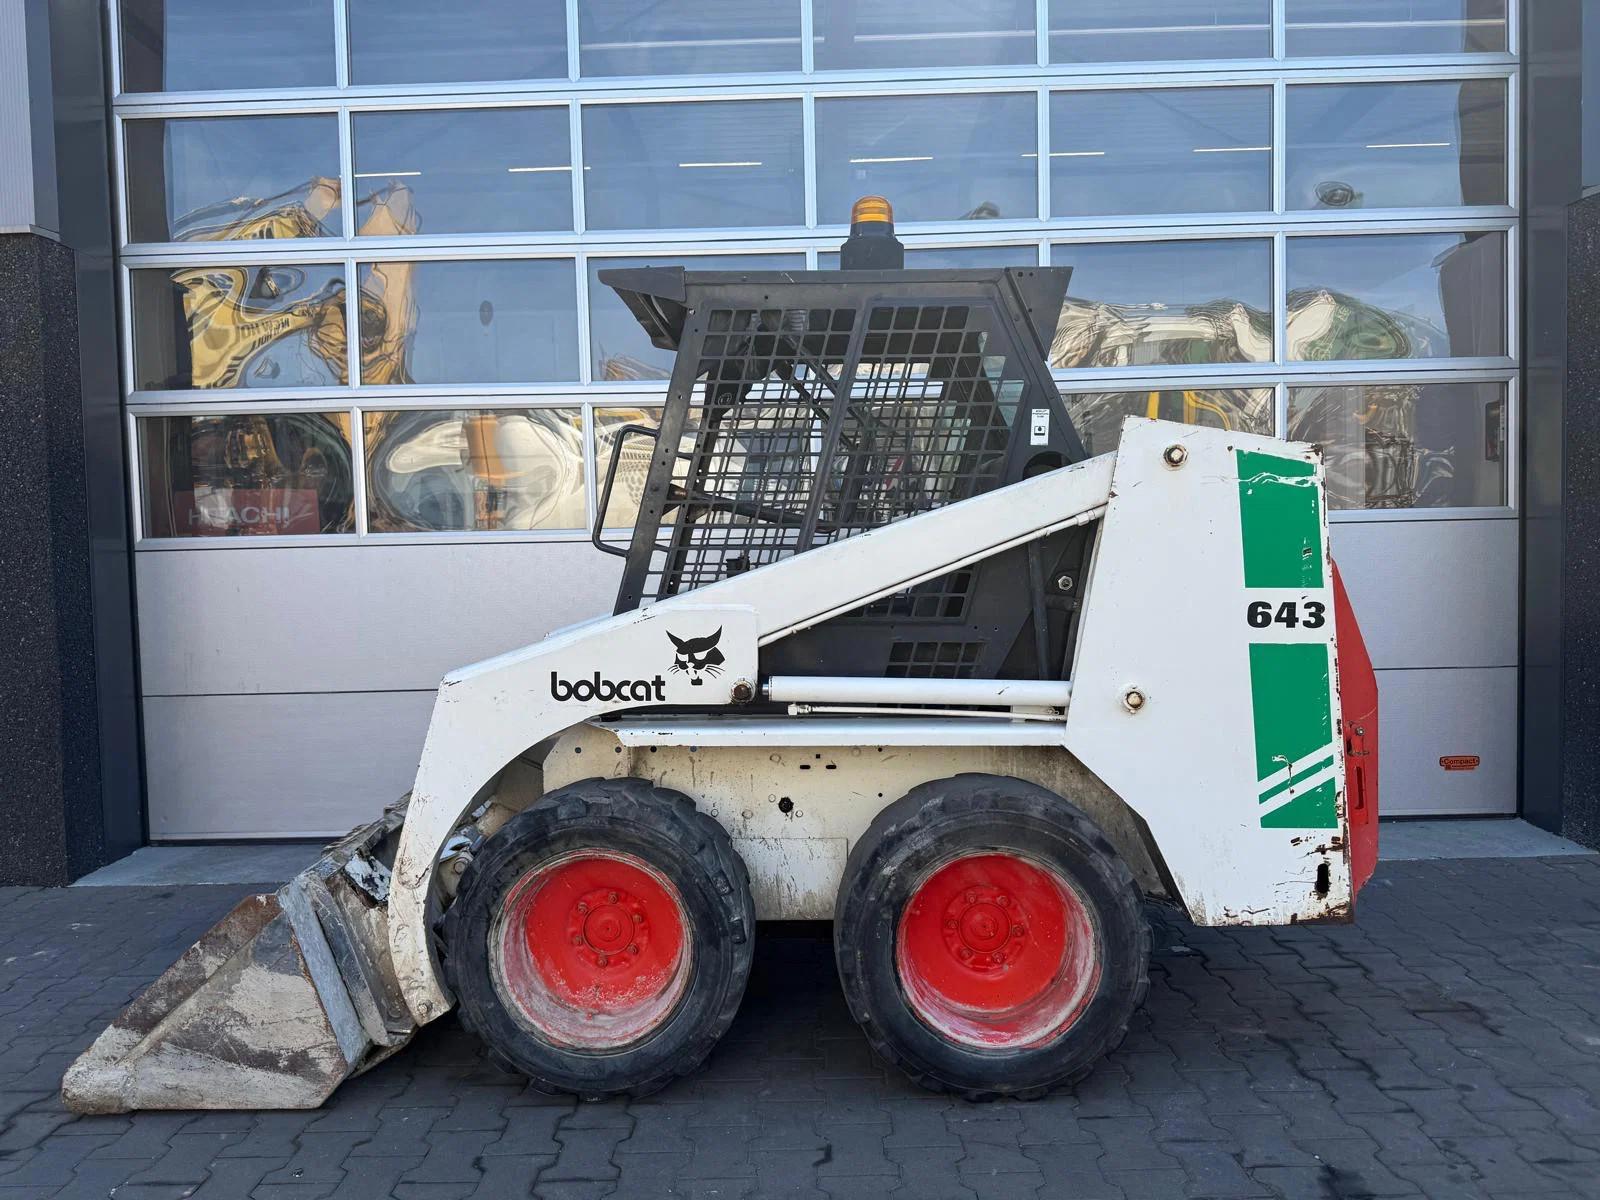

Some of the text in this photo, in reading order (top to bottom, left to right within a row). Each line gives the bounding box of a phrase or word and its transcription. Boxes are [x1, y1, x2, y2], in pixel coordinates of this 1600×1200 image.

[189, 506, 290, 526] HACHI
[1247, 601, 1325, 628] 643
[551, 671, 665, 702] bobcat
